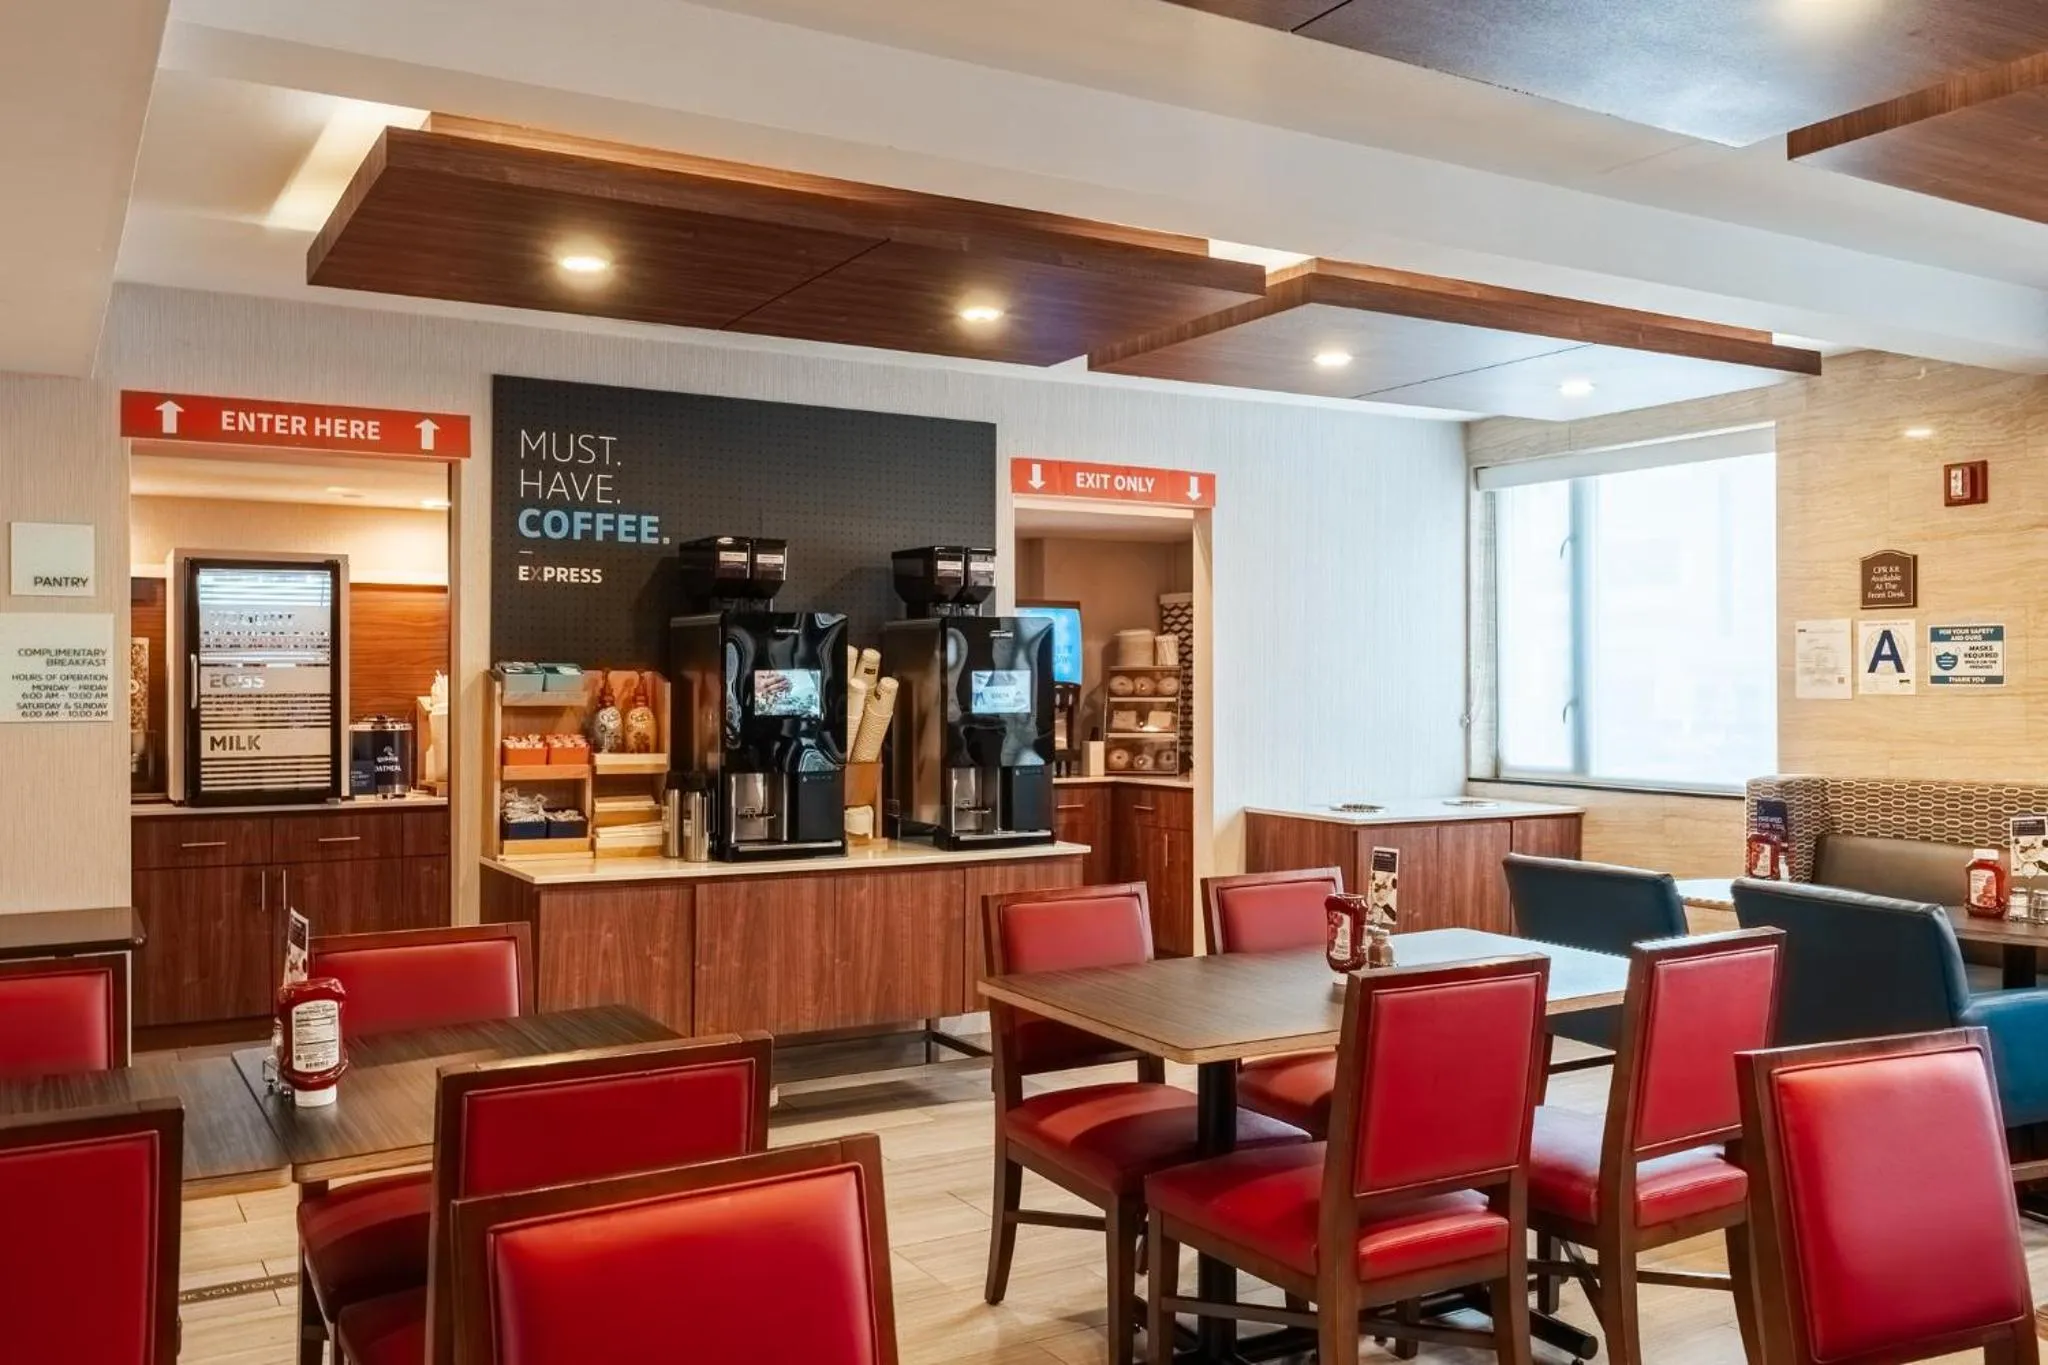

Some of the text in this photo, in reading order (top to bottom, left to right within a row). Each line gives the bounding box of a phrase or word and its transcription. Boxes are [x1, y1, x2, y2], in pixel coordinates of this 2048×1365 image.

[221, 410, 381, 440] ENTER HERE
[520, 428, 622, 466] MUST.
[520, 468, 621, 504] HAVE.
[1075, 471, 1155, 493] EXIT ONLY
[518, 508, 670, 545] COFFEE.
[33, 575, 89, 588] PANTRY
[518, 565, 602, 584] EXPRESS
[17, 647, 107, 657] COMPLIMENTARY
[1867, 629, 1906, 674] A
[46, 658, 106, 667] BREAKFAST
[11, 673, 109, 682] HOURS OF OPERATION
[44, 691, 60, 699] AM
[78, 683, 108, 691] FRIDAY
[16, 702, 61, 710] SATURDAY
[209, 734, 262, 752] MILK
